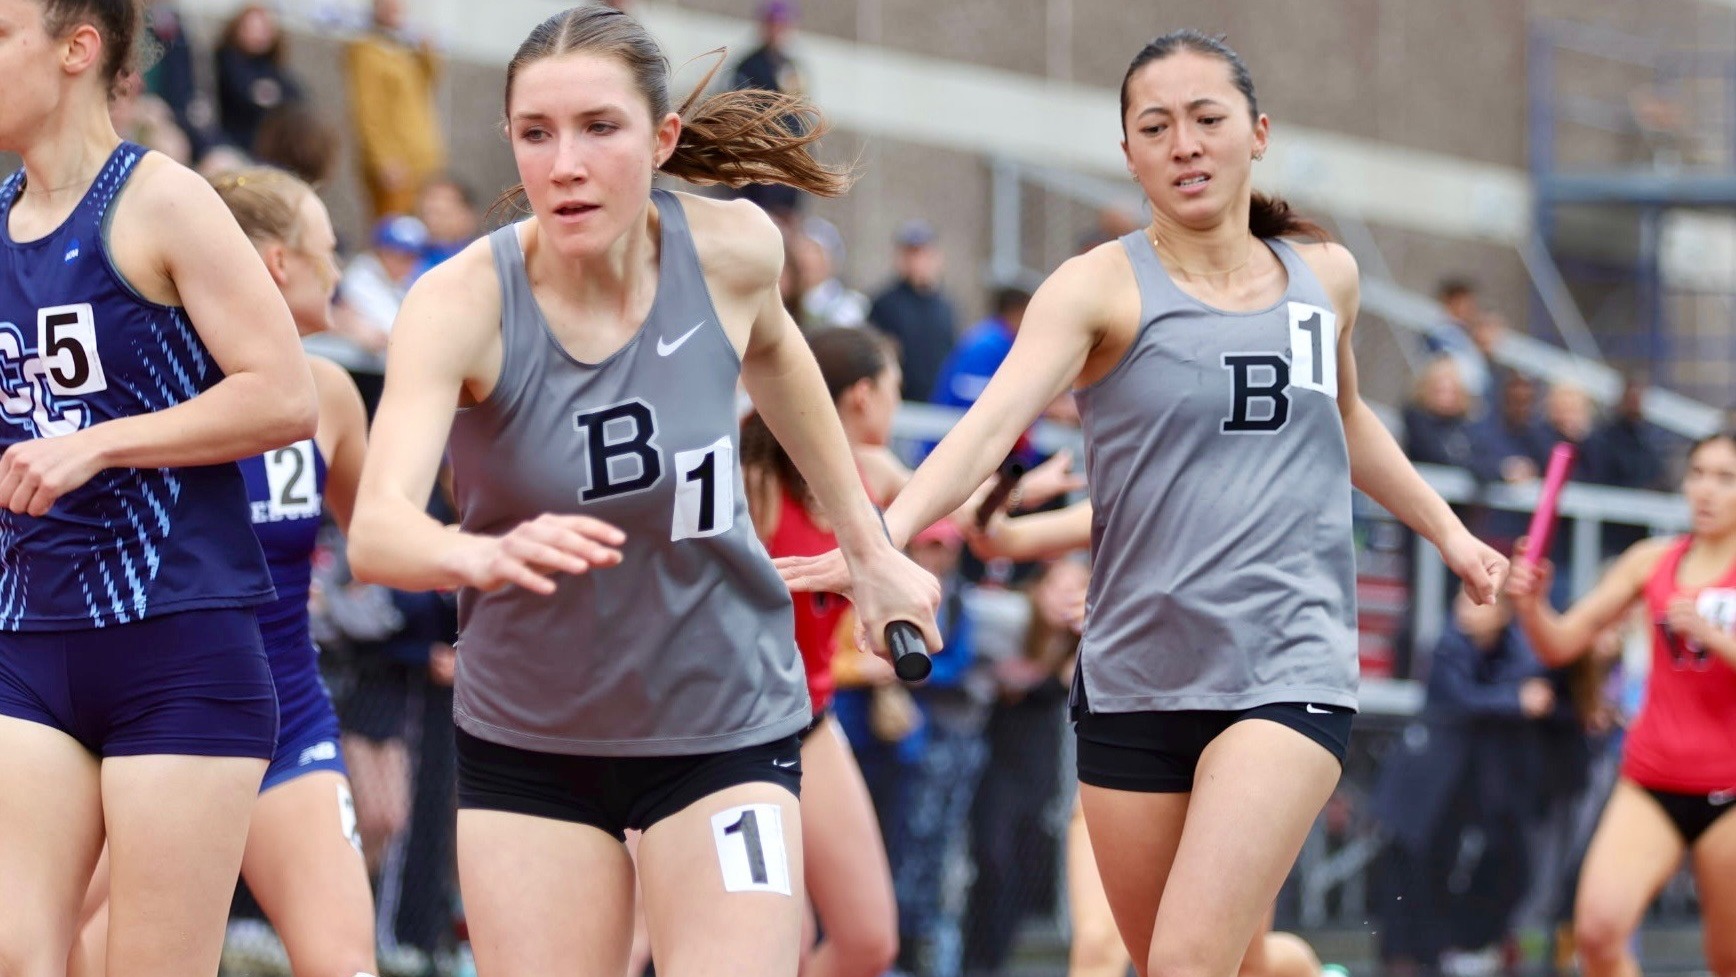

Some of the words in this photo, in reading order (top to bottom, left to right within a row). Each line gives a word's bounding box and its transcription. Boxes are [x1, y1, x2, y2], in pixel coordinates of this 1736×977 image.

[46, 312, 89, 389] 5
[1298, 312, 1323, 385] 1
[1220, 351, 1292, 435] B
[274, 446, 308, 505] 2
[573, 397, 665, 505] B
[686, 451, 715, 532] 1
[723, 809, 768, 884] 1
